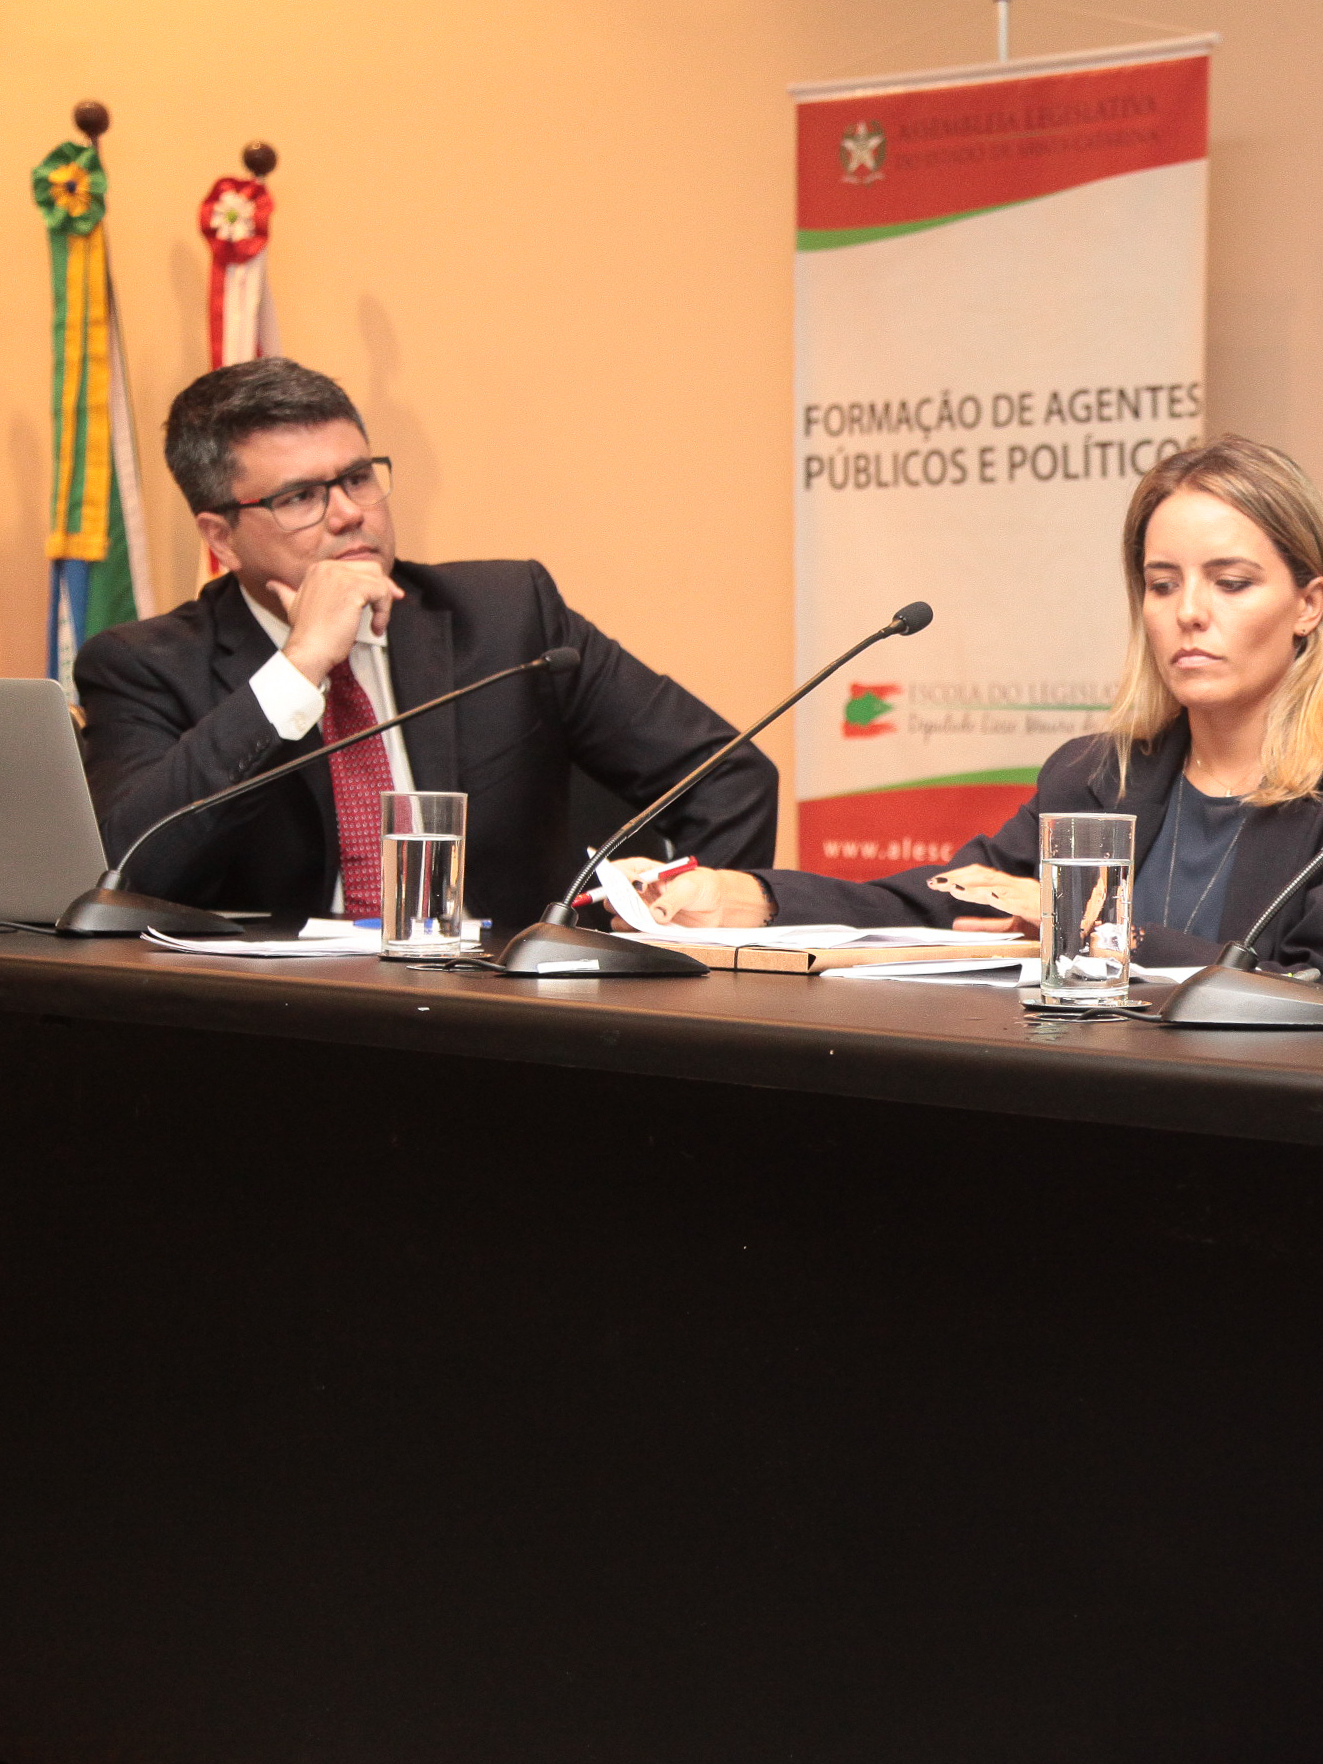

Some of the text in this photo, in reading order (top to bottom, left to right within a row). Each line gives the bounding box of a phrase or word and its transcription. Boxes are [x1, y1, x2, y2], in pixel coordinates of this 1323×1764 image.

[803, 383, 1202, 442] FORMAÇÃO DE AGENTES
[804, 433, 1200, 491] PÚBLICOS E POLÍTICO
